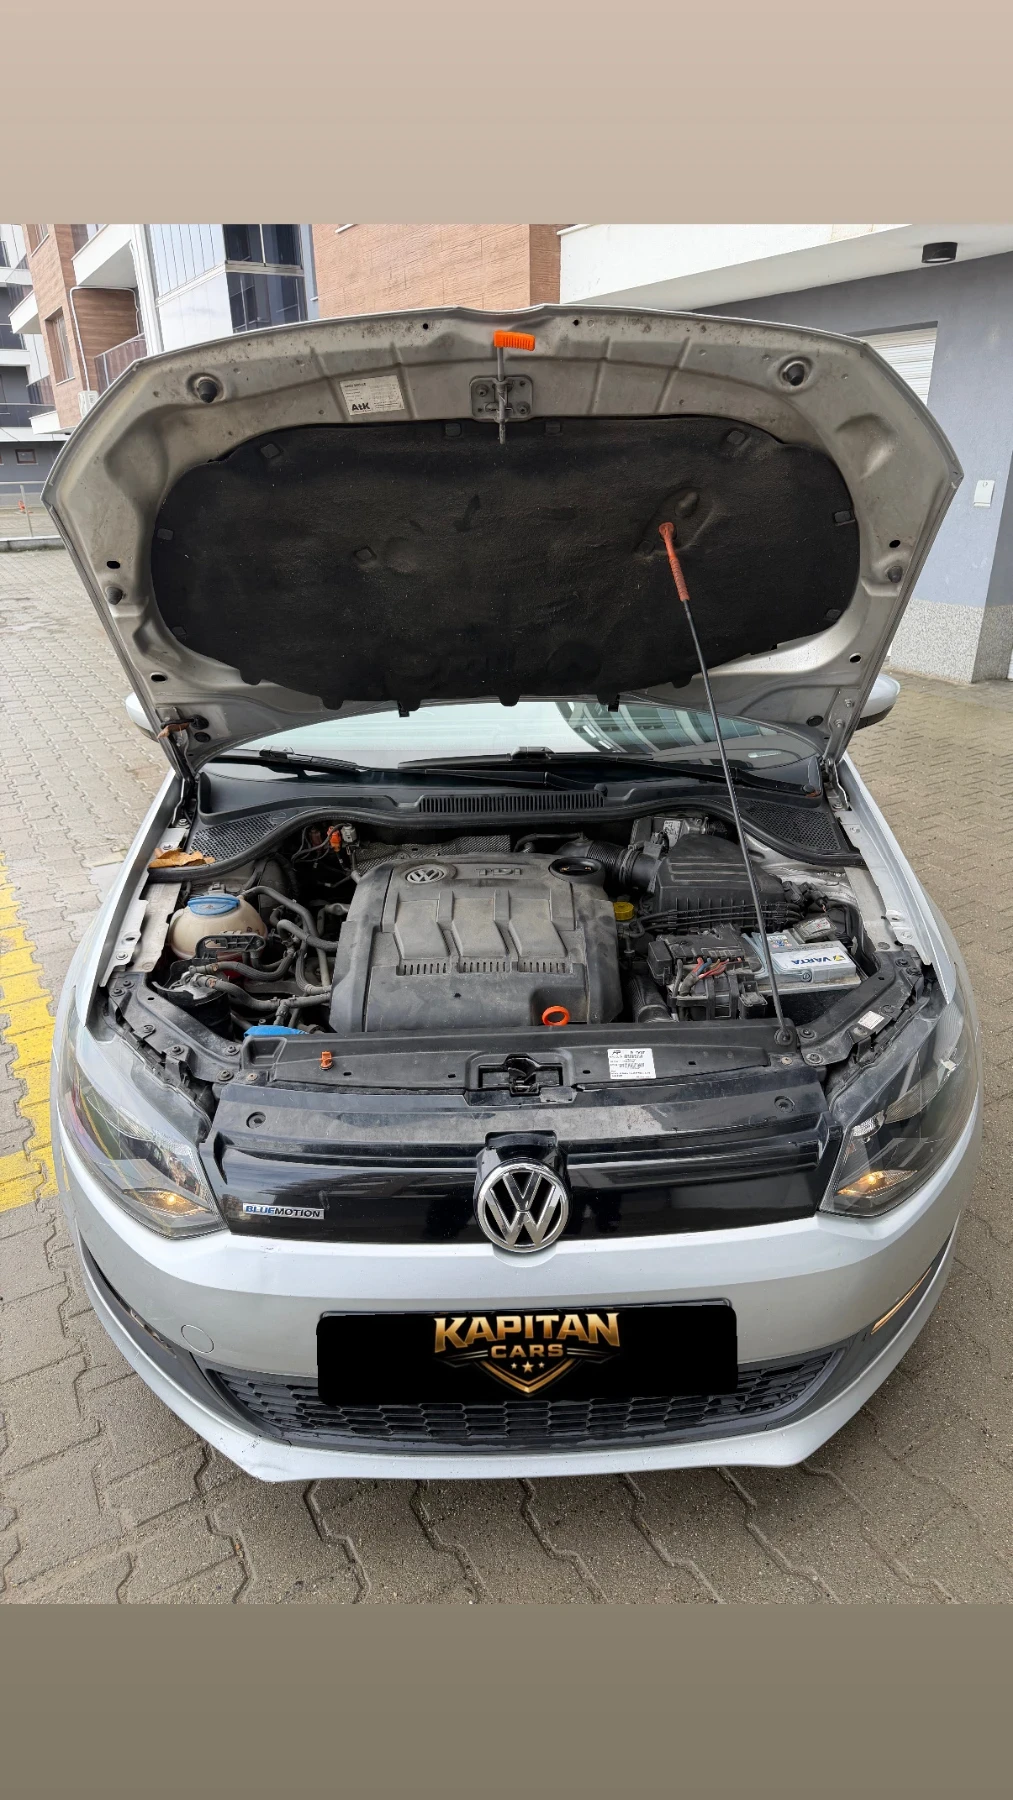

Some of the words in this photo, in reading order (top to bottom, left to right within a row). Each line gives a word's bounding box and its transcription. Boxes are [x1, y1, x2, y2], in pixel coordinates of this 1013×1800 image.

[475, 867, 522, 876] TDI
[791, 956, 832, 965] VARTA
[245, 1205, 320, 1218] BLUEMOTION
[479, 1164, 567, 1250] VW
